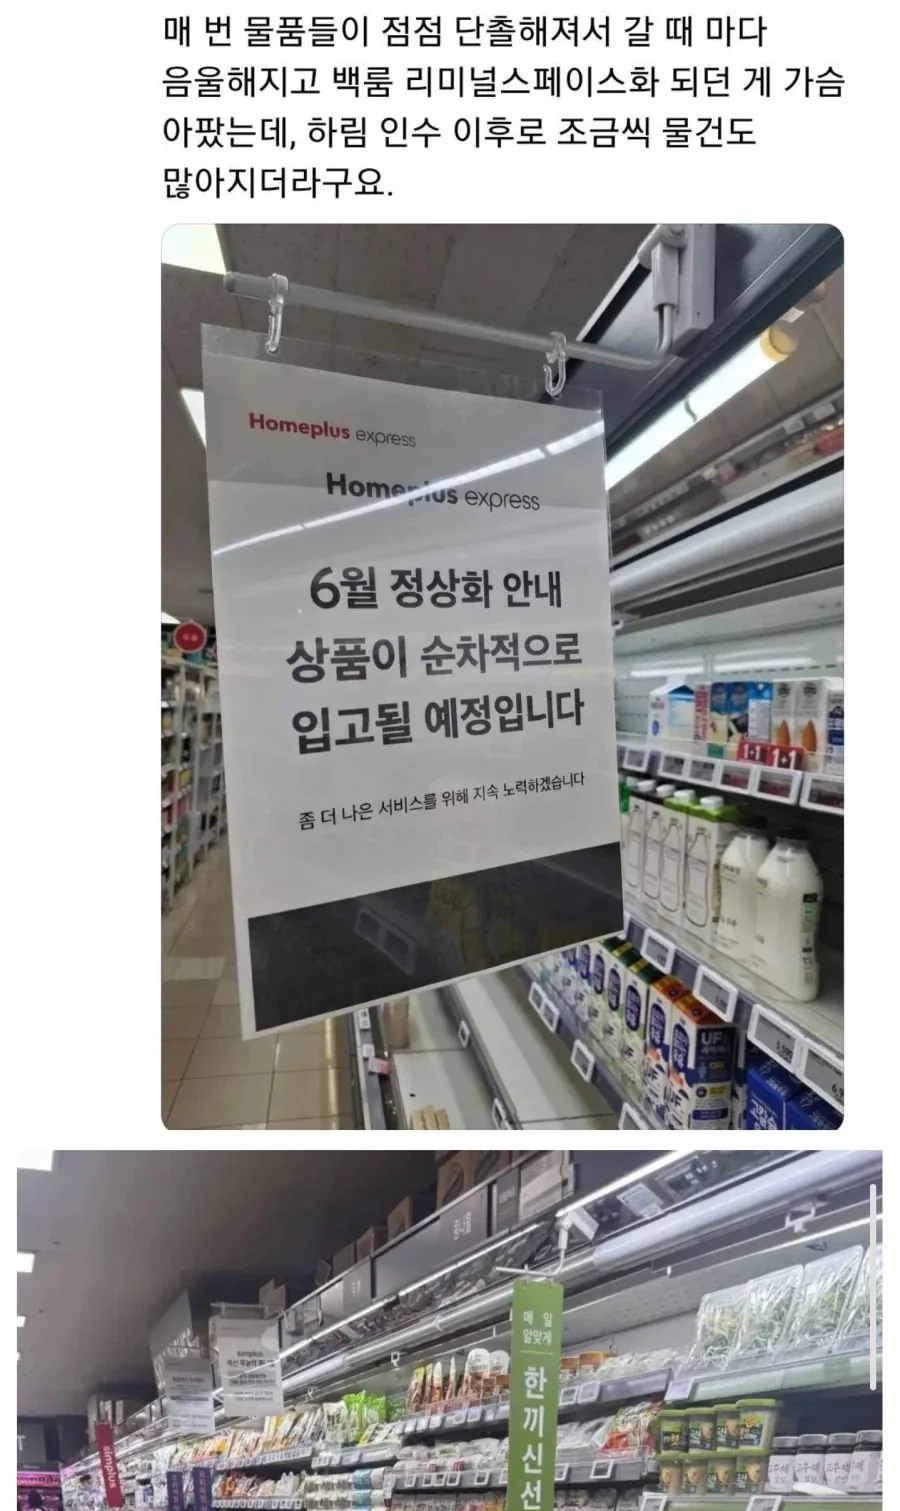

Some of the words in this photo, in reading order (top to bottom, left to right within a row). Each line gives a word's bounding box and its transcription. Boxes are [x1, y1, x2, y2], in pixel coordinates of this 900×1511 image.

[249, 412, 350, 440] Homeplus
[355, 427, 417, 448] express
[326, 472, 458, 507] Homeplus
[464, 488, 541, 512] express
[310, 566, 377, 610] 6월
[390, 569, 493, 608] 정상화
[502, 570, 562, 608] 안내
[286, 635, 408, 684] 상품이
[421, 632, 583, 676] 순차적으로
[292, 700, 413, 755] 입고될
[424, 688, 585, 739] 예정입니다
[742, 743, 762, 761] 1+1
[771, 748, 797, 770] 1+1
[298, 811, 316, 831] 좀
[321, 808, 336, 826] 더
[341, 802, 374, 823] 나은
[378, 793, 438, 816] 서비스를
[441, 790, 469, 807] 위해
[472, 785, 500, 801] 지속
[502, 771, 586, 797] 노력하겠습니다
[522, 1328, 553, 1346] 알맞게
[102, 1445, 118, 1489] simplus
